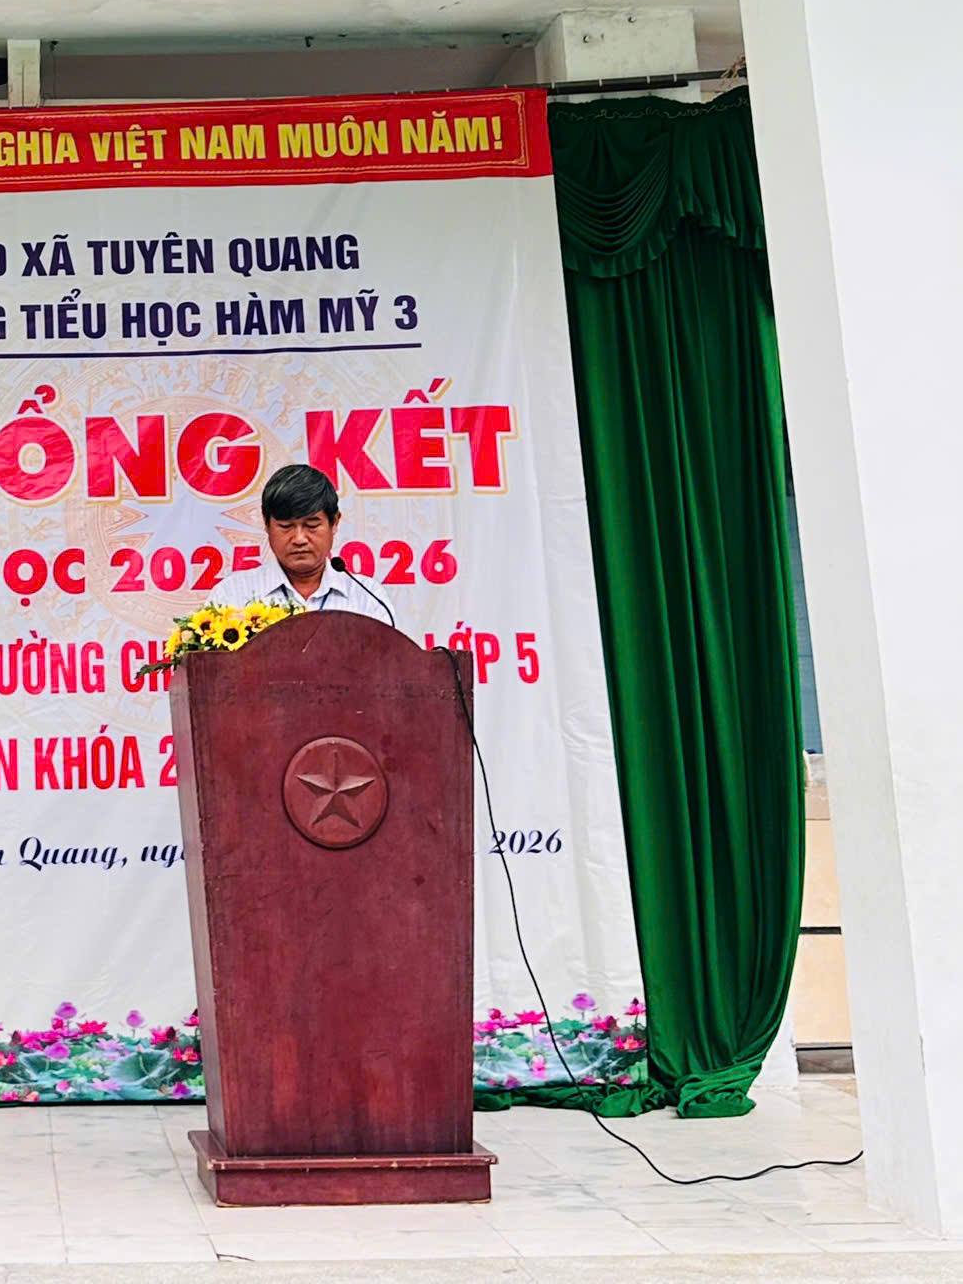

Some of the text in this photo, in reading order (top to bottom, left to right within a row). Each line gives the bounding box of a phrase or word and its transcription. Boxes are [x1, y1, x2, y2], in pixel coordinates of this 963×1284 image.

[91, 125, 166, 168] VIỆT
[181, 125, 265, 159] NAM
[279, 116, 388, 157] MUÔN
[401, 112, 501, 153] NĂM!
[22, 234, 75, 276] XÃ
[87, 232, 214, 275] TUYÊN
[229, 234, 359, 277] QUANG
[20, 289, 106, 339] TIỂU
[122, 302, 200, 346] HỌC
[216, 292, 305, 335] HÀM
[319, 289, 378, 333] MỸ
[394, 295, 417, 330] 3
[306, 377, 511, 490] KẾT
[330, 539, 458, 585] 026
[120, 640, 173, 693] CH
[515, 632, 540, 684] 5
[35, 725, 145, 790] KHÓA
[19, 836, 128, 872] Quang,
[488, 828, 562, 854] 2026
